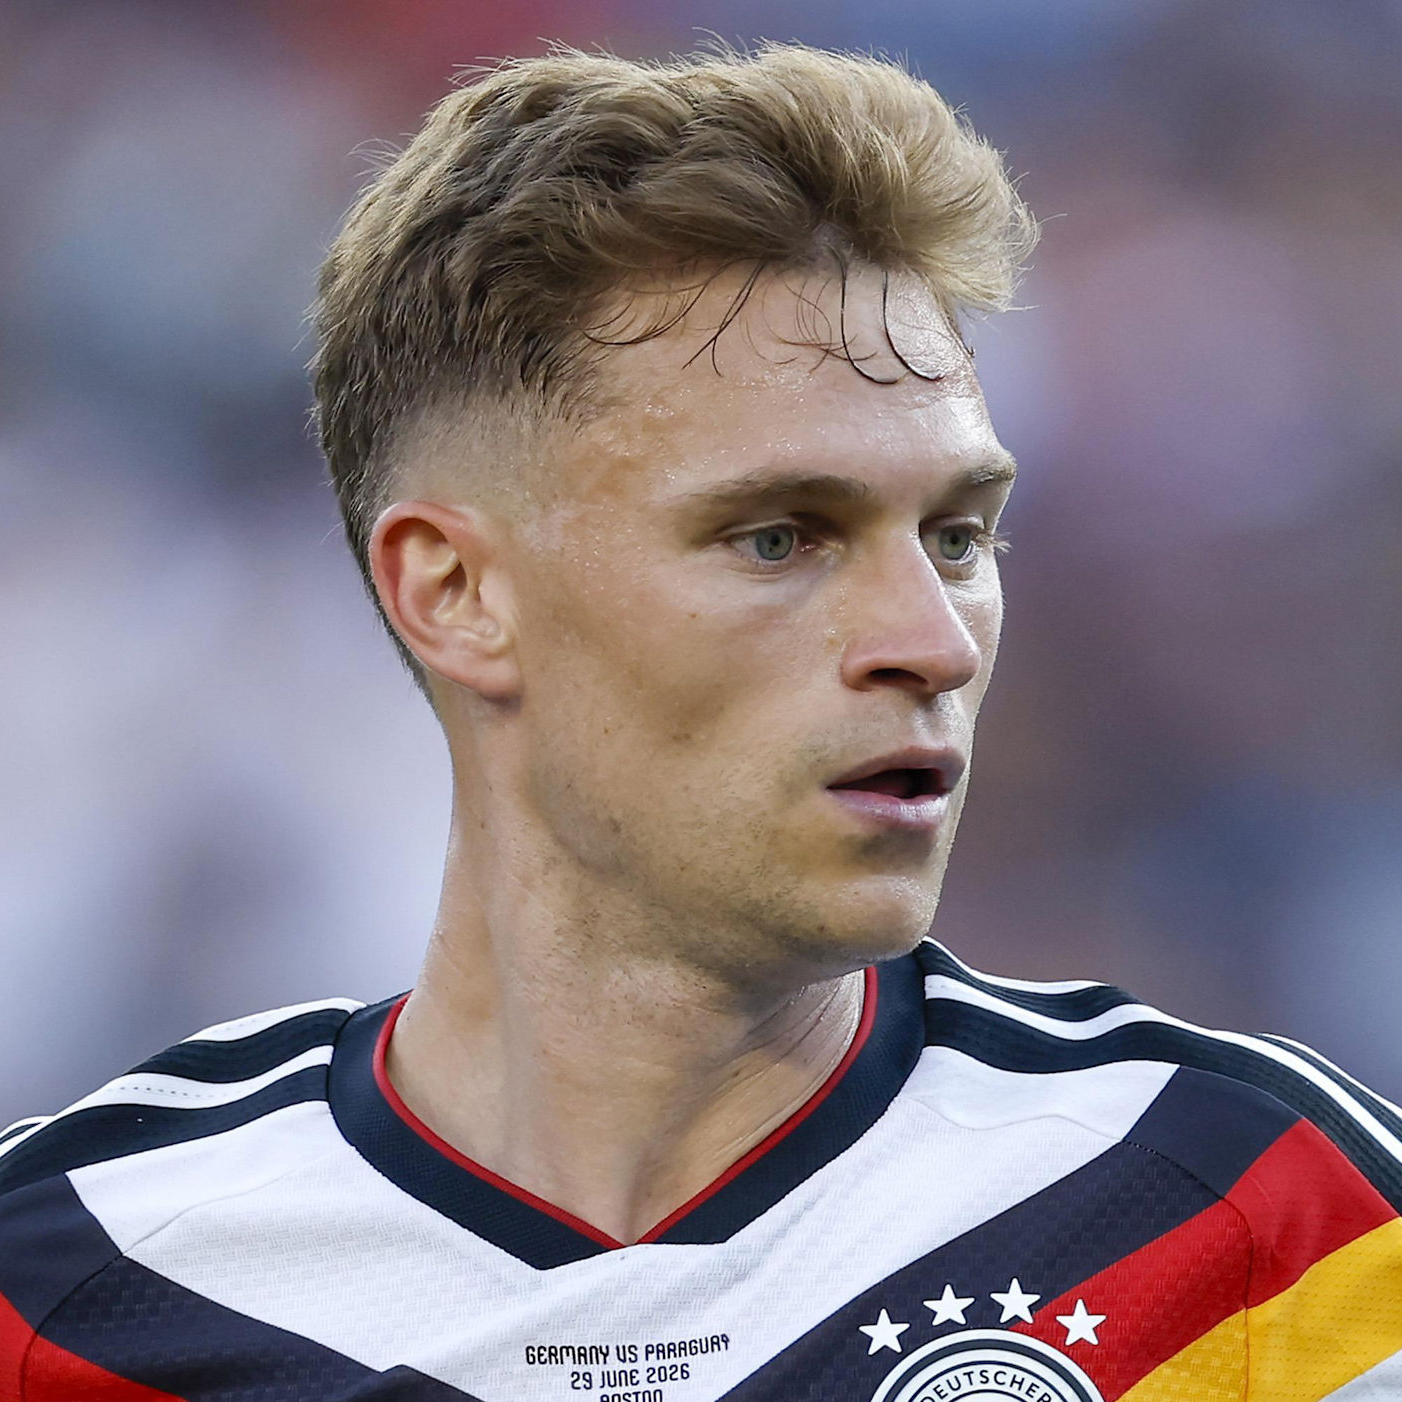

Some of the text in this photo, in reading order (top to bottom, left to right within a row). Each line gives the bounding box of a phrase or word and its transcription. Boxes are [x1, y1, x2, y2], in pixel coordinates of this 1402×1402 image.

[525, 1345, 610, 1365] GERMANY
[616, 1344, 639, 1364] VS
[571, 1363, 691, 1390] 29 JUNE 2026
